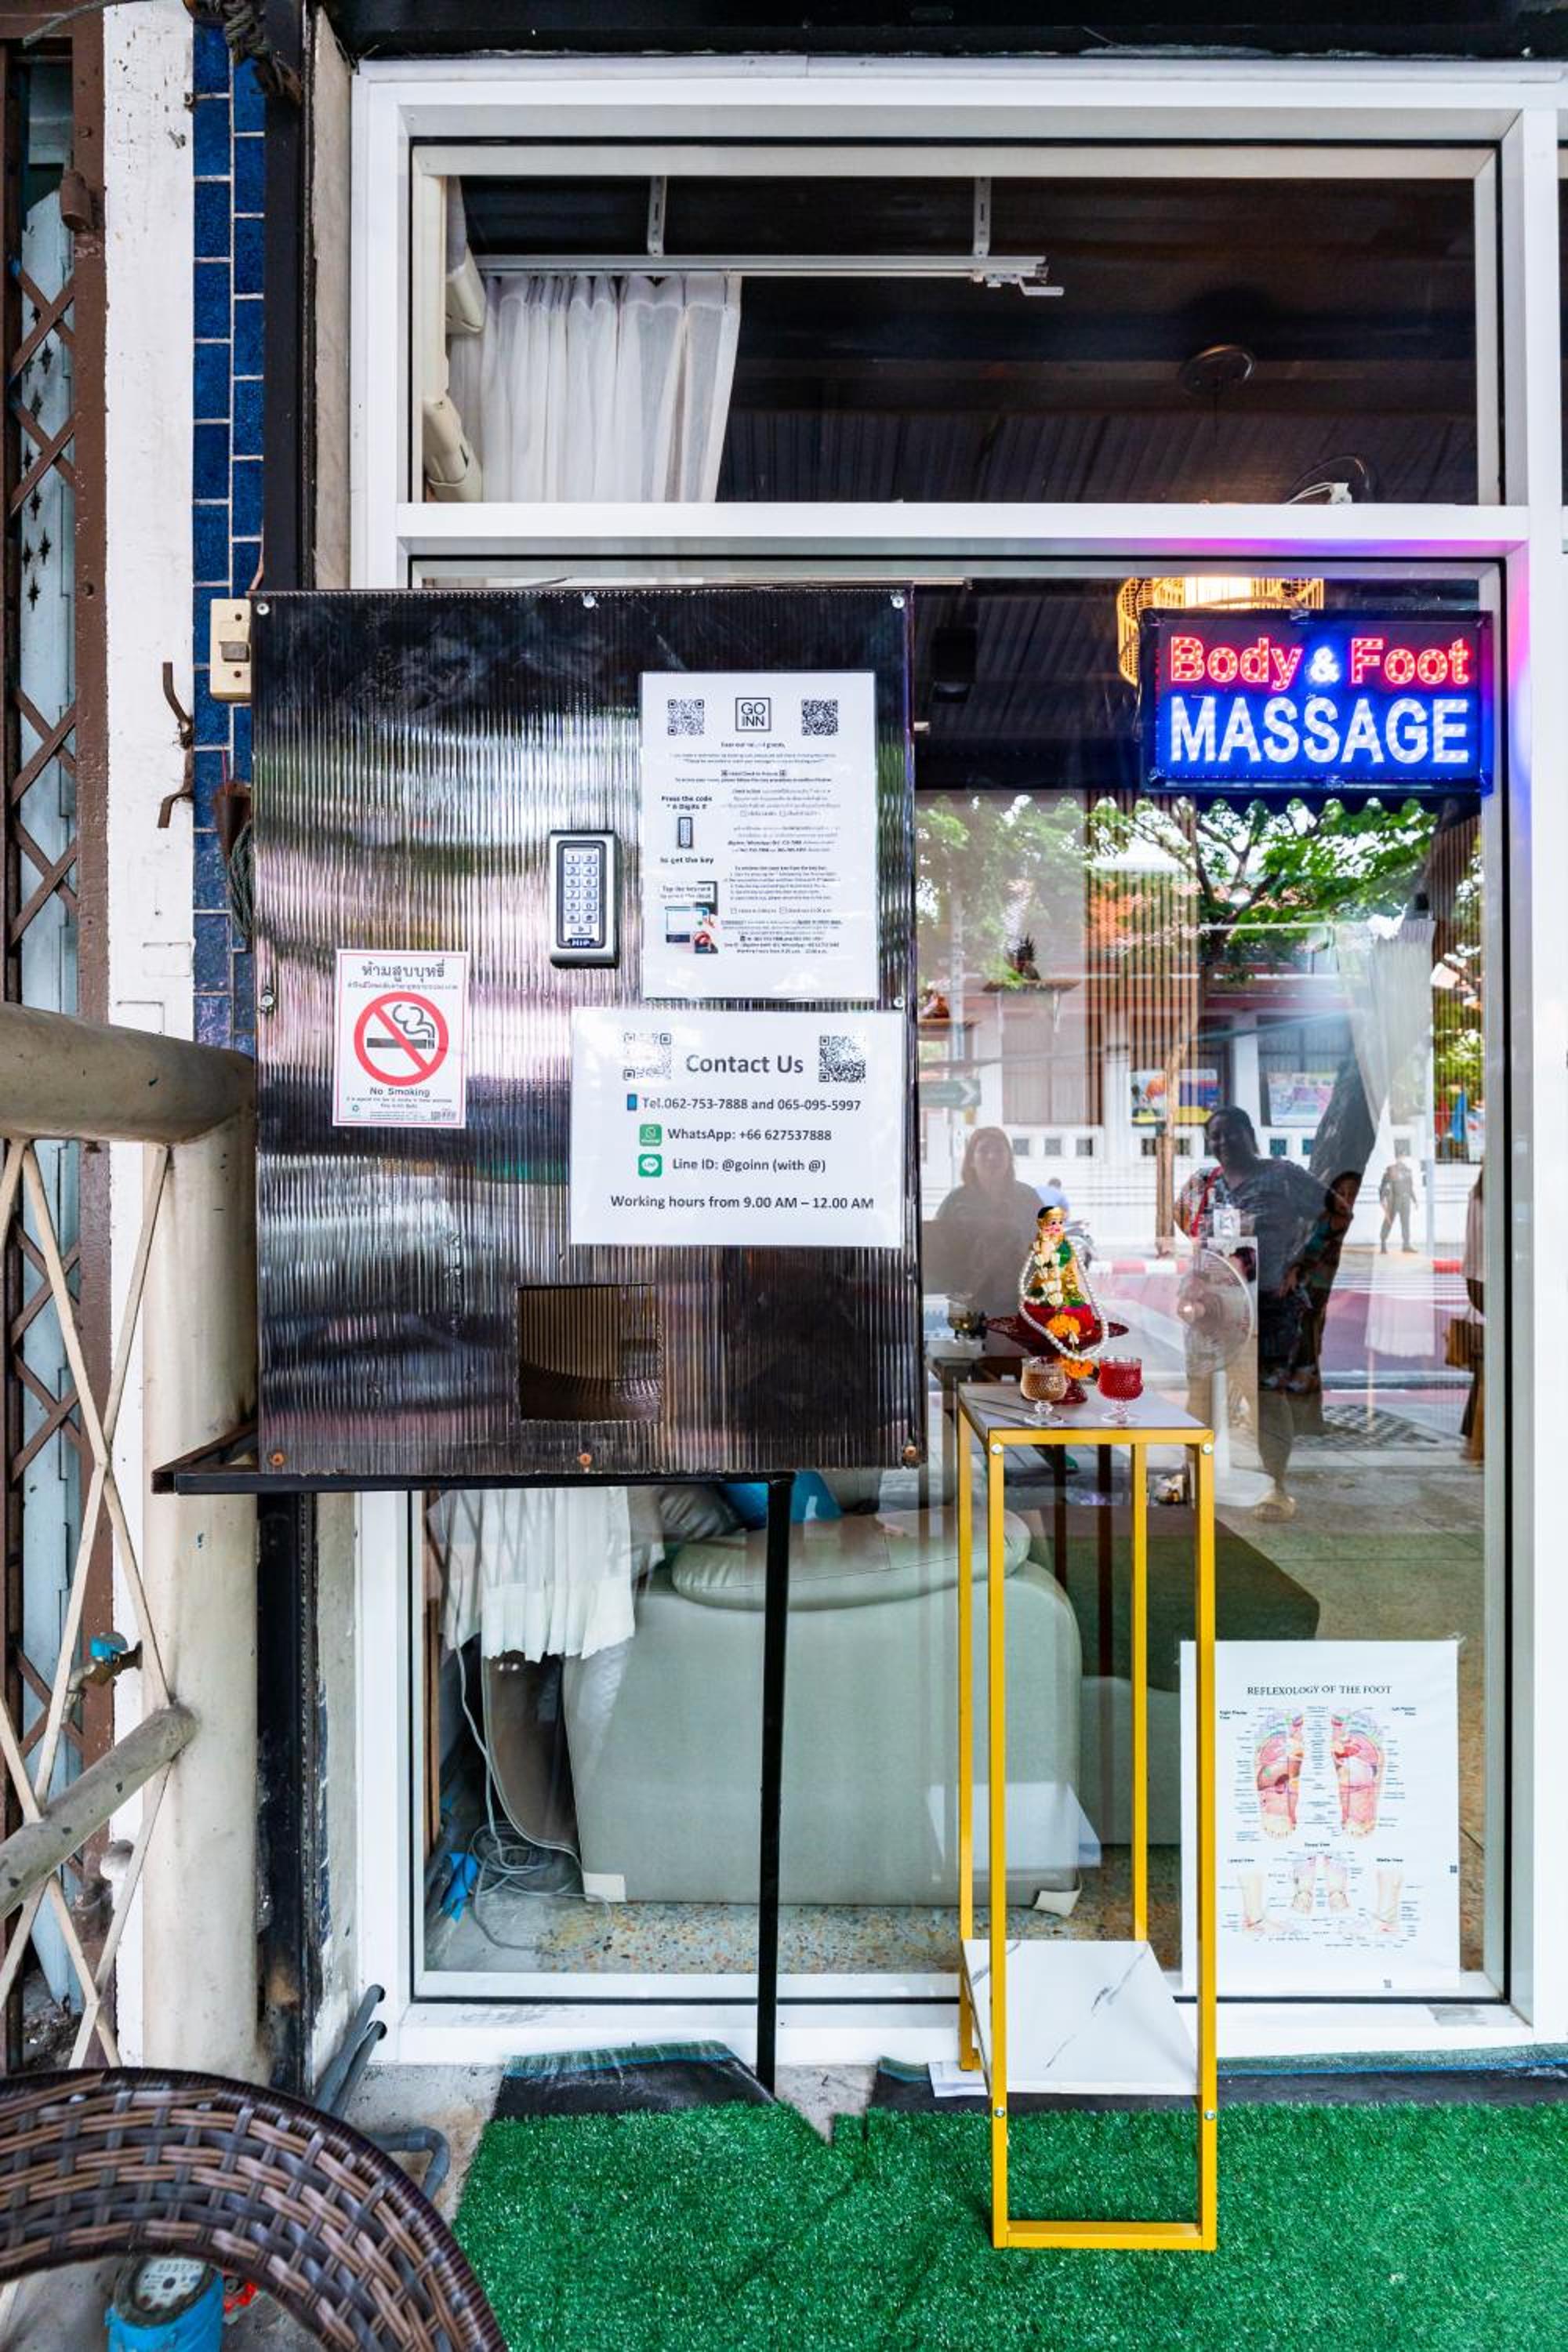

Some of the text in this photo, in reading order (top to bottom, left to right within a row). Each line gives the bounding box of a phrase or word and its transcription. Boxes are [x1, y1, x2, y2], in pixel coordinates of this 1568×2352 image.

[1171, 636, 1469, 691] Body & Foot
[741, 702, 765, 715] GO
[742, 717, 764, 727] INN
[1171, 695, 1468, 764] MASSAGE
[687, 1055, 803, 1073] Contact Us
[388, 1087, 430, 1098] Smoking
[751, 1099, 774, 1109] and
[778, 1099, 861, 1110] 065-095-5997
[668, 1129, 831, 1142] WhatsApp: +66 627537888
[673, 1159, 826, 1173] Line ID: @goinn (with @)
[611, 1196, 665, 1209] Working
[669, 1196, 705, 1207] hours
[709, 1196, 739, 1207] from
[743, 1196, 771, 1207] 9.00
[775, 1197, 797, 1208] AM
[813, 1197, 848, 1209] 12.00
[851, 1198, 873, 1208] AM
[1247, 1686, 1319, 1695] REFLEXOLOGY
[1322, 1685, 1336, 1693] OF
